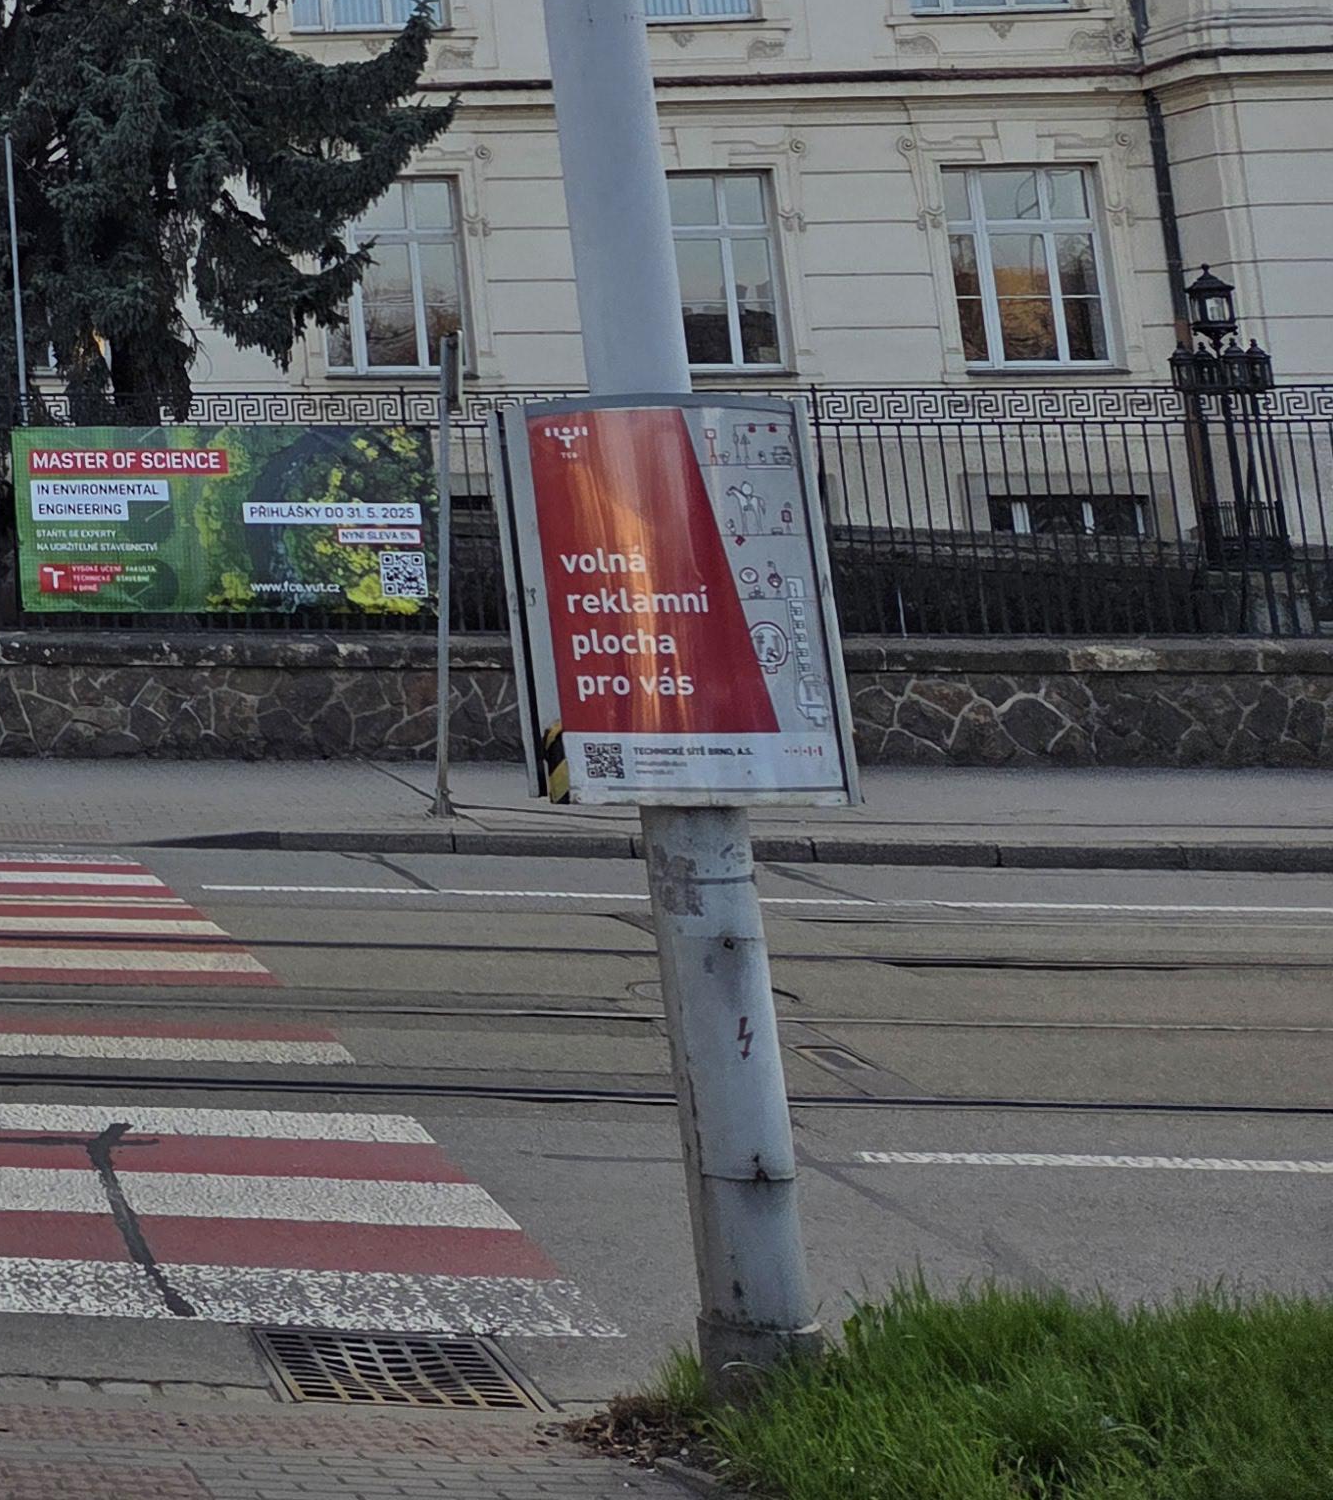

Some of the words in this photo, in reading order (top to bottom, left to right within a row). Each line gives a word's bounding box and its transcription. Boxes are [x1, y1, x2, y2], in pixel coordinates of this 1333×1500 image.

[33, 452, 108, 469] MASTER
[112, 452, 137, 469] OF
[140, 452, 221, 469] SCIENCE
[37, 484, 50, 496] IN
[53, 483, 159, 496] ENVIRONMENTAL
[38, 503, 122, 515] ENGINEERING
[250, 505, 322, 518] PŘIHLÁŠKY
[325, 507, 345, 518] DO
[347, 507, 364, 518] 31.
[367, 507, 378, 518] 5.
[382, 507, 415, 519] 2025
[36, 528, 67, 538] STAŇTE
[68, 529, 79, 538] SE
[80, 529, 116, 538] EXPERTY
[341, 530, 365, 540] NYNÍ
[367, 531, 398, 540] SLEVA
[400, 531, 415, 540] 5%
[36, 542, 49, 551] NA
[559, 545, 647, 574] volná
[250, 580, 341, 593] www.fce.vut.cz
[566, 585, 710, 614] reklamní
[572, 628, 677, 661] plocha
[576, 674, 631, 702] pro
[639, 667, 695, 696] vás
